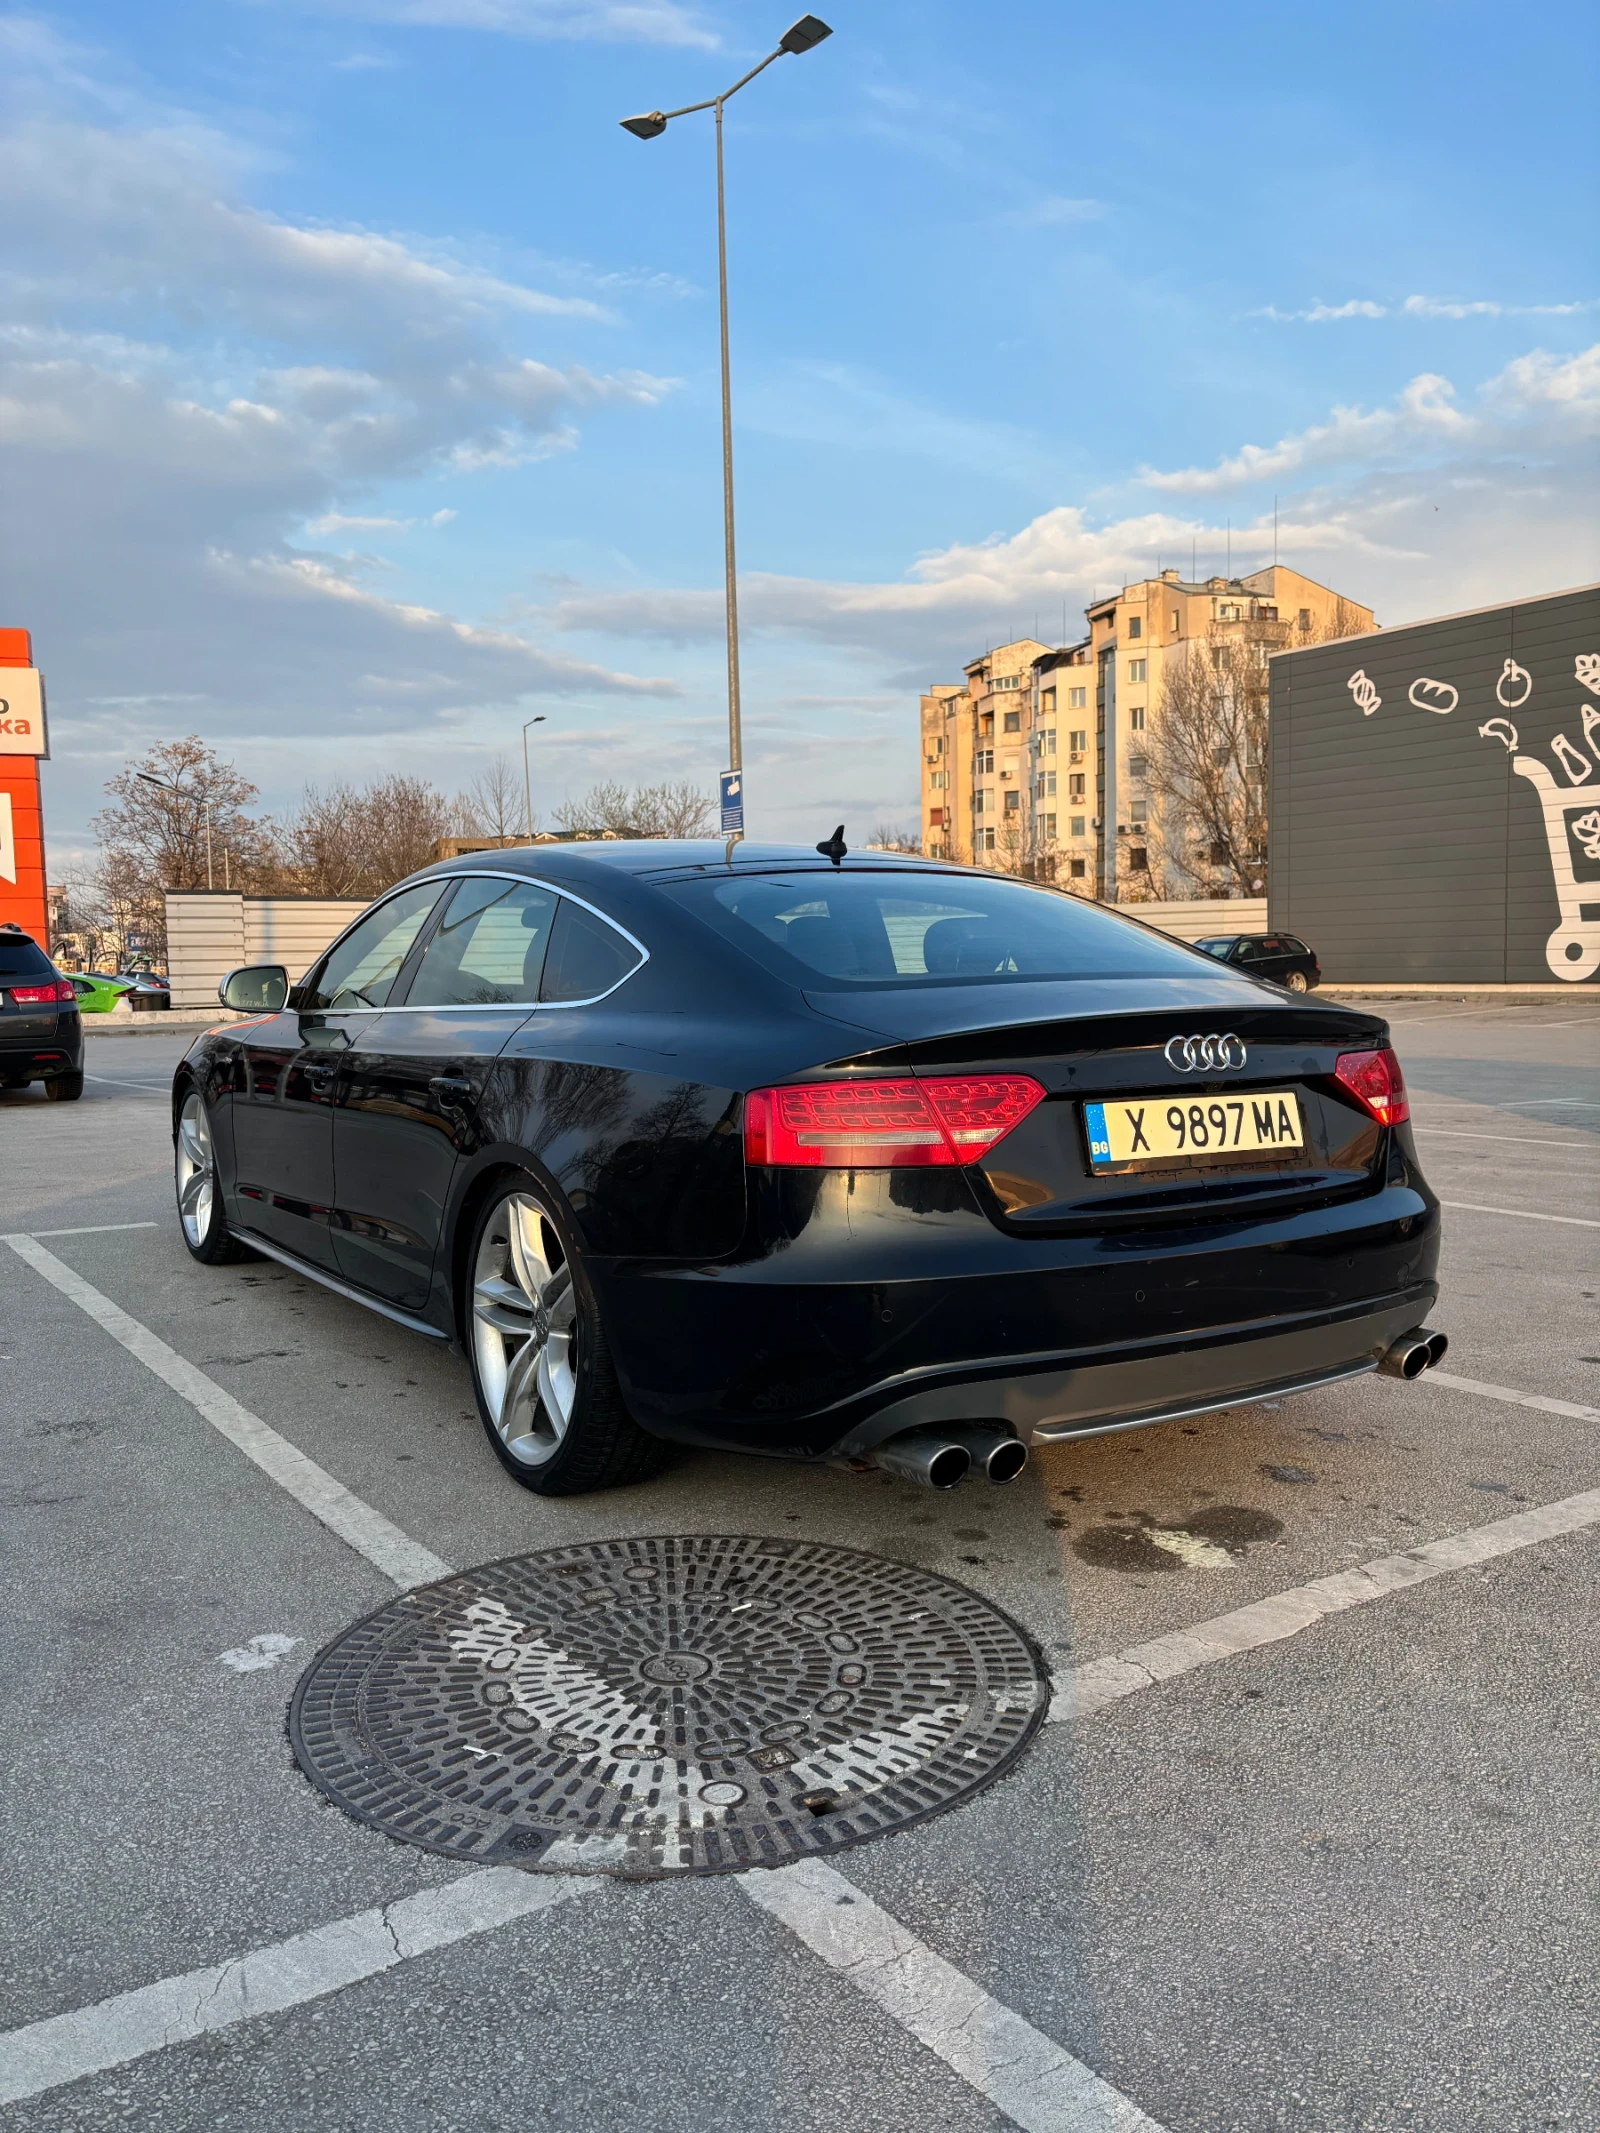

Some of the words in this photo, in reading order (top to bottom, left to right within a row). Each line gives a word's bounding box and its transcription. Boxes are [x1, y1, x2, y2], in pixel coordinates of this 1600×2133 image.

[1125, 1108, 1151, 1152] X
[1166, 1103, 1245, 1149] 9897
[1251, 1100, 1296, 1143] MA
[1091, 1141, 1109, 1155] BG
